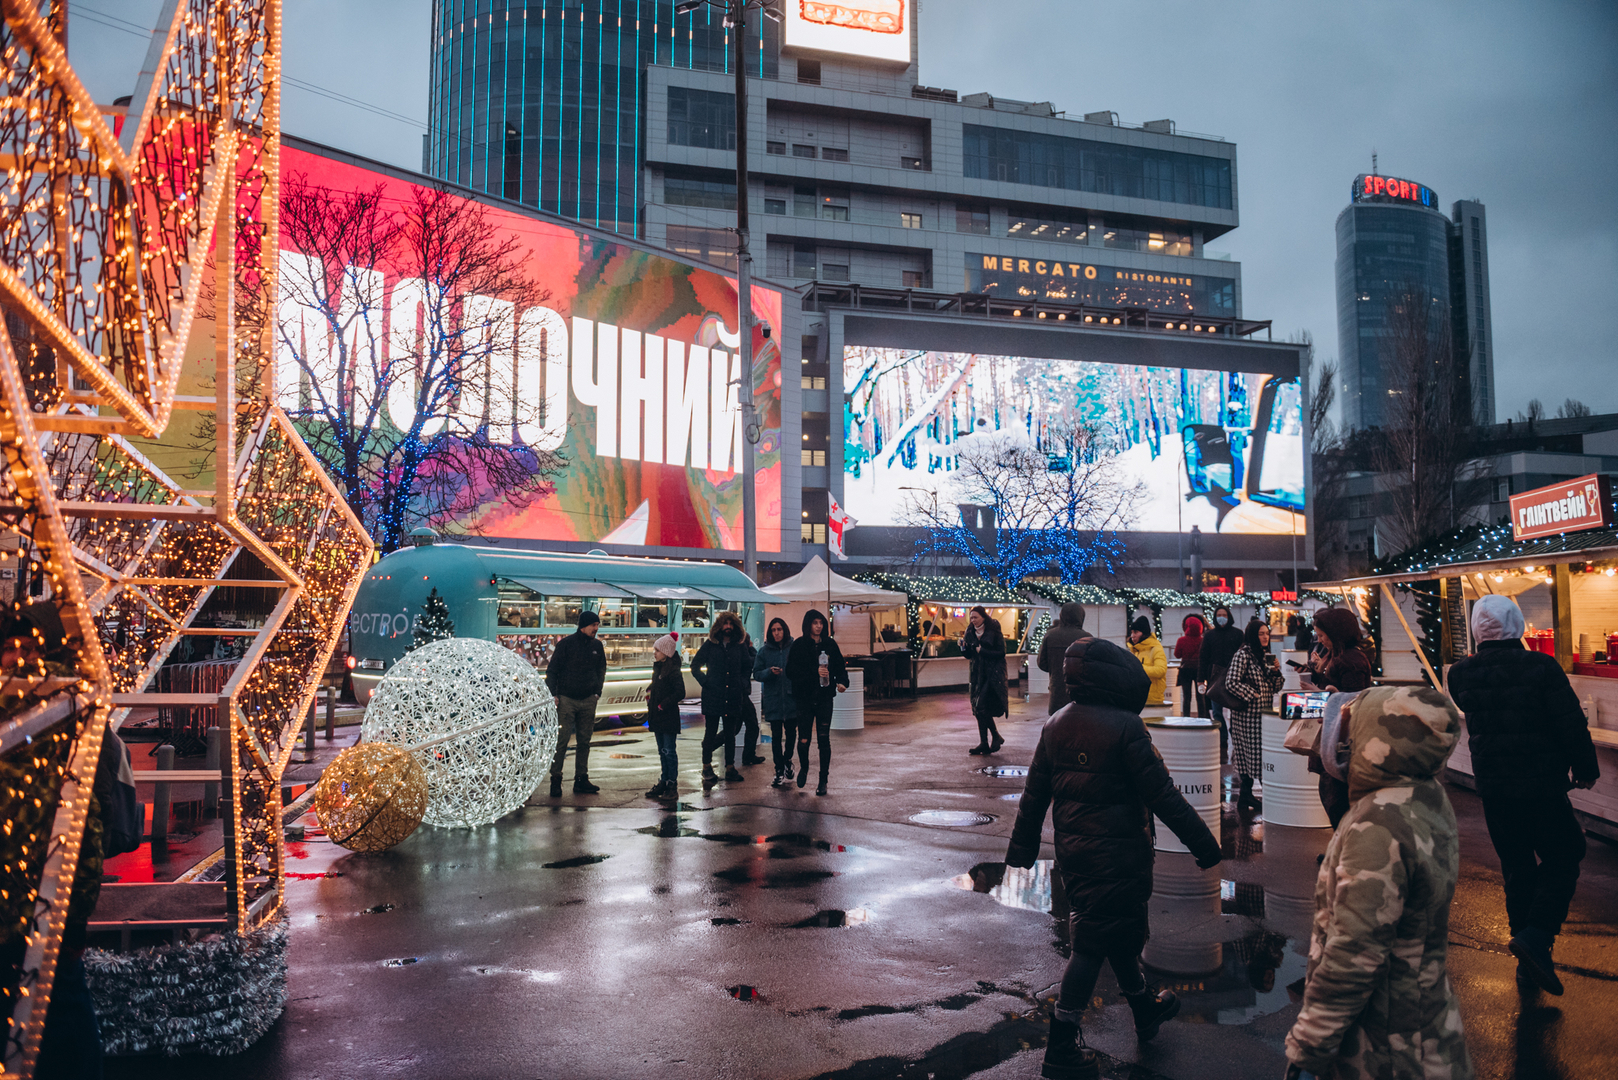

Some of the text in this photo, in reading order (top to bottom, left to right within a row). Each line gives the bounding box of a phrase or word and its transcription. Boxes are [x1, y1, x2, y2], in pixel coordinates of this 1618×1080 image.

[1364, 175, 1418, 201] SPORT
[983, 256, 1192, 286] MERCATO RISTORANTE
[277, 249, 743, 474] МОЛОЧНИЙ
[1519, 490, 1587, 529] ГЛІНТВЕЙН
[1175, 784, 1213, 794] LLIVER
